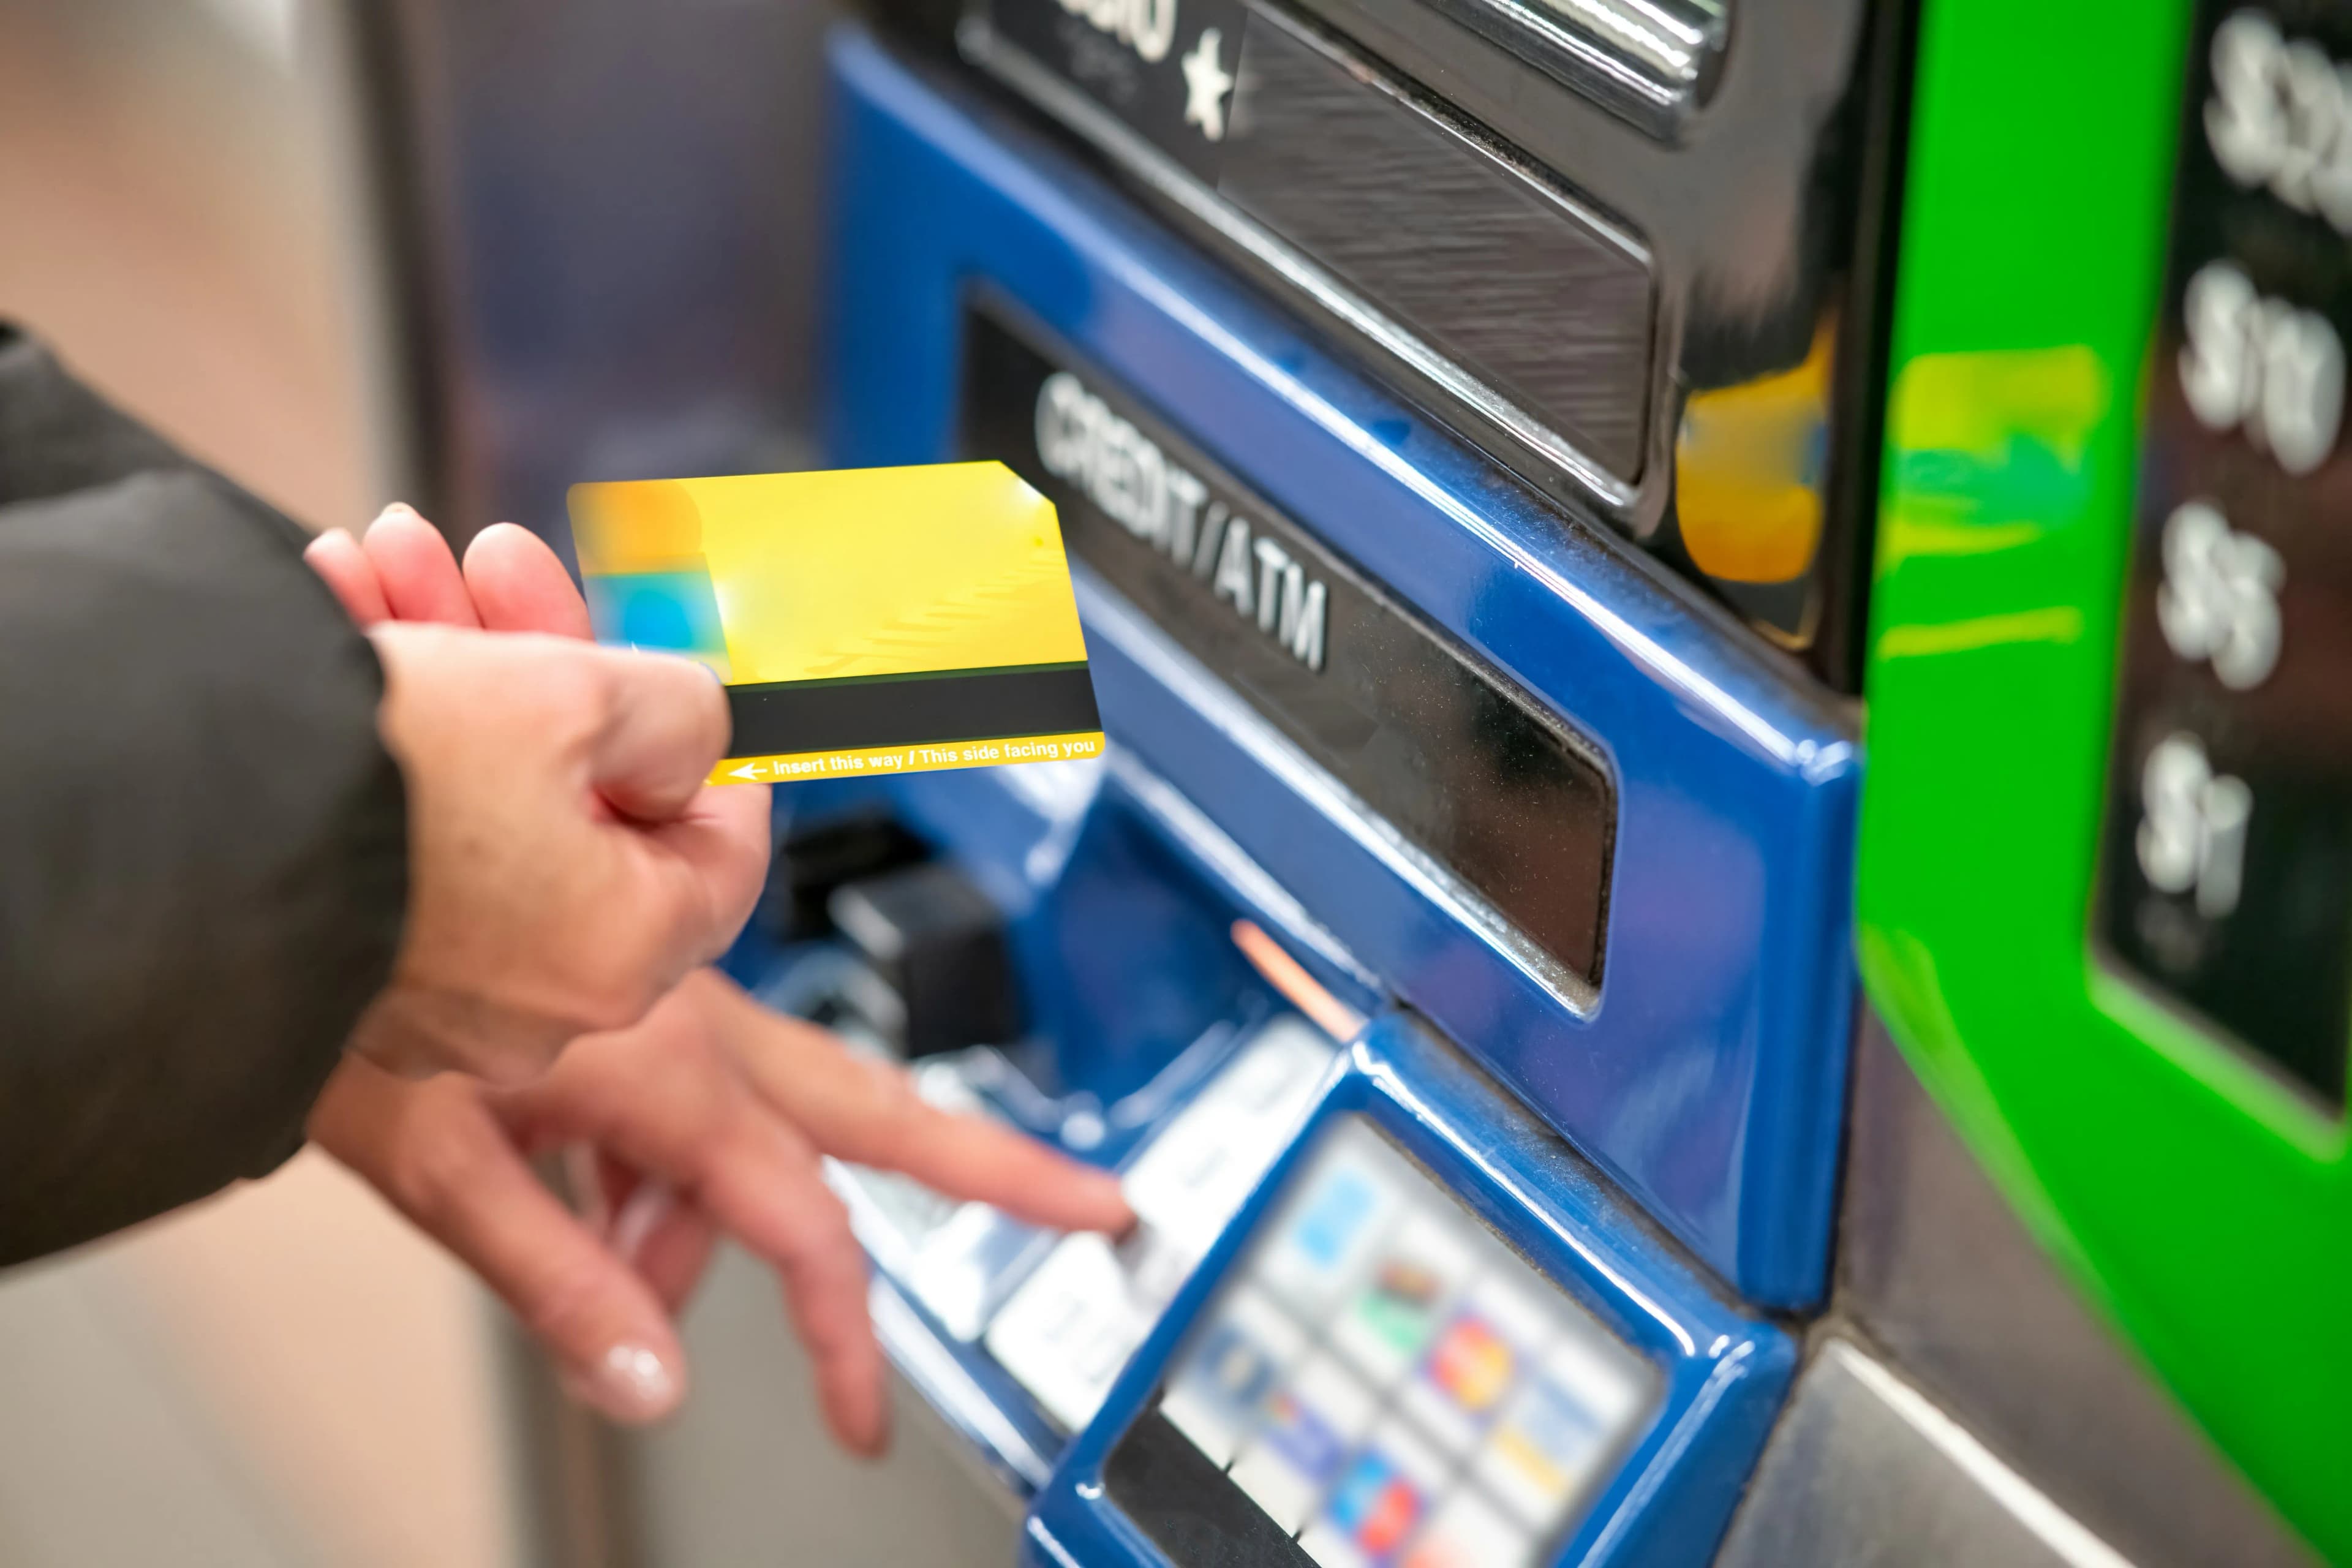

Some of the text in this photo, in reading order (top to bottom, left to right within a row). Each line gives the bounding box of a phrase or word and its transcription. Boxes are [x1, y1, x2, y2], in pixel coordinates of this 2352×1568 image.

[1035, 372, 1325, 671] CREDIT/ATM
[2157, 503, 2286, 689] $5
[773, 741, 1096, 775] Insert this way / This side facing you
